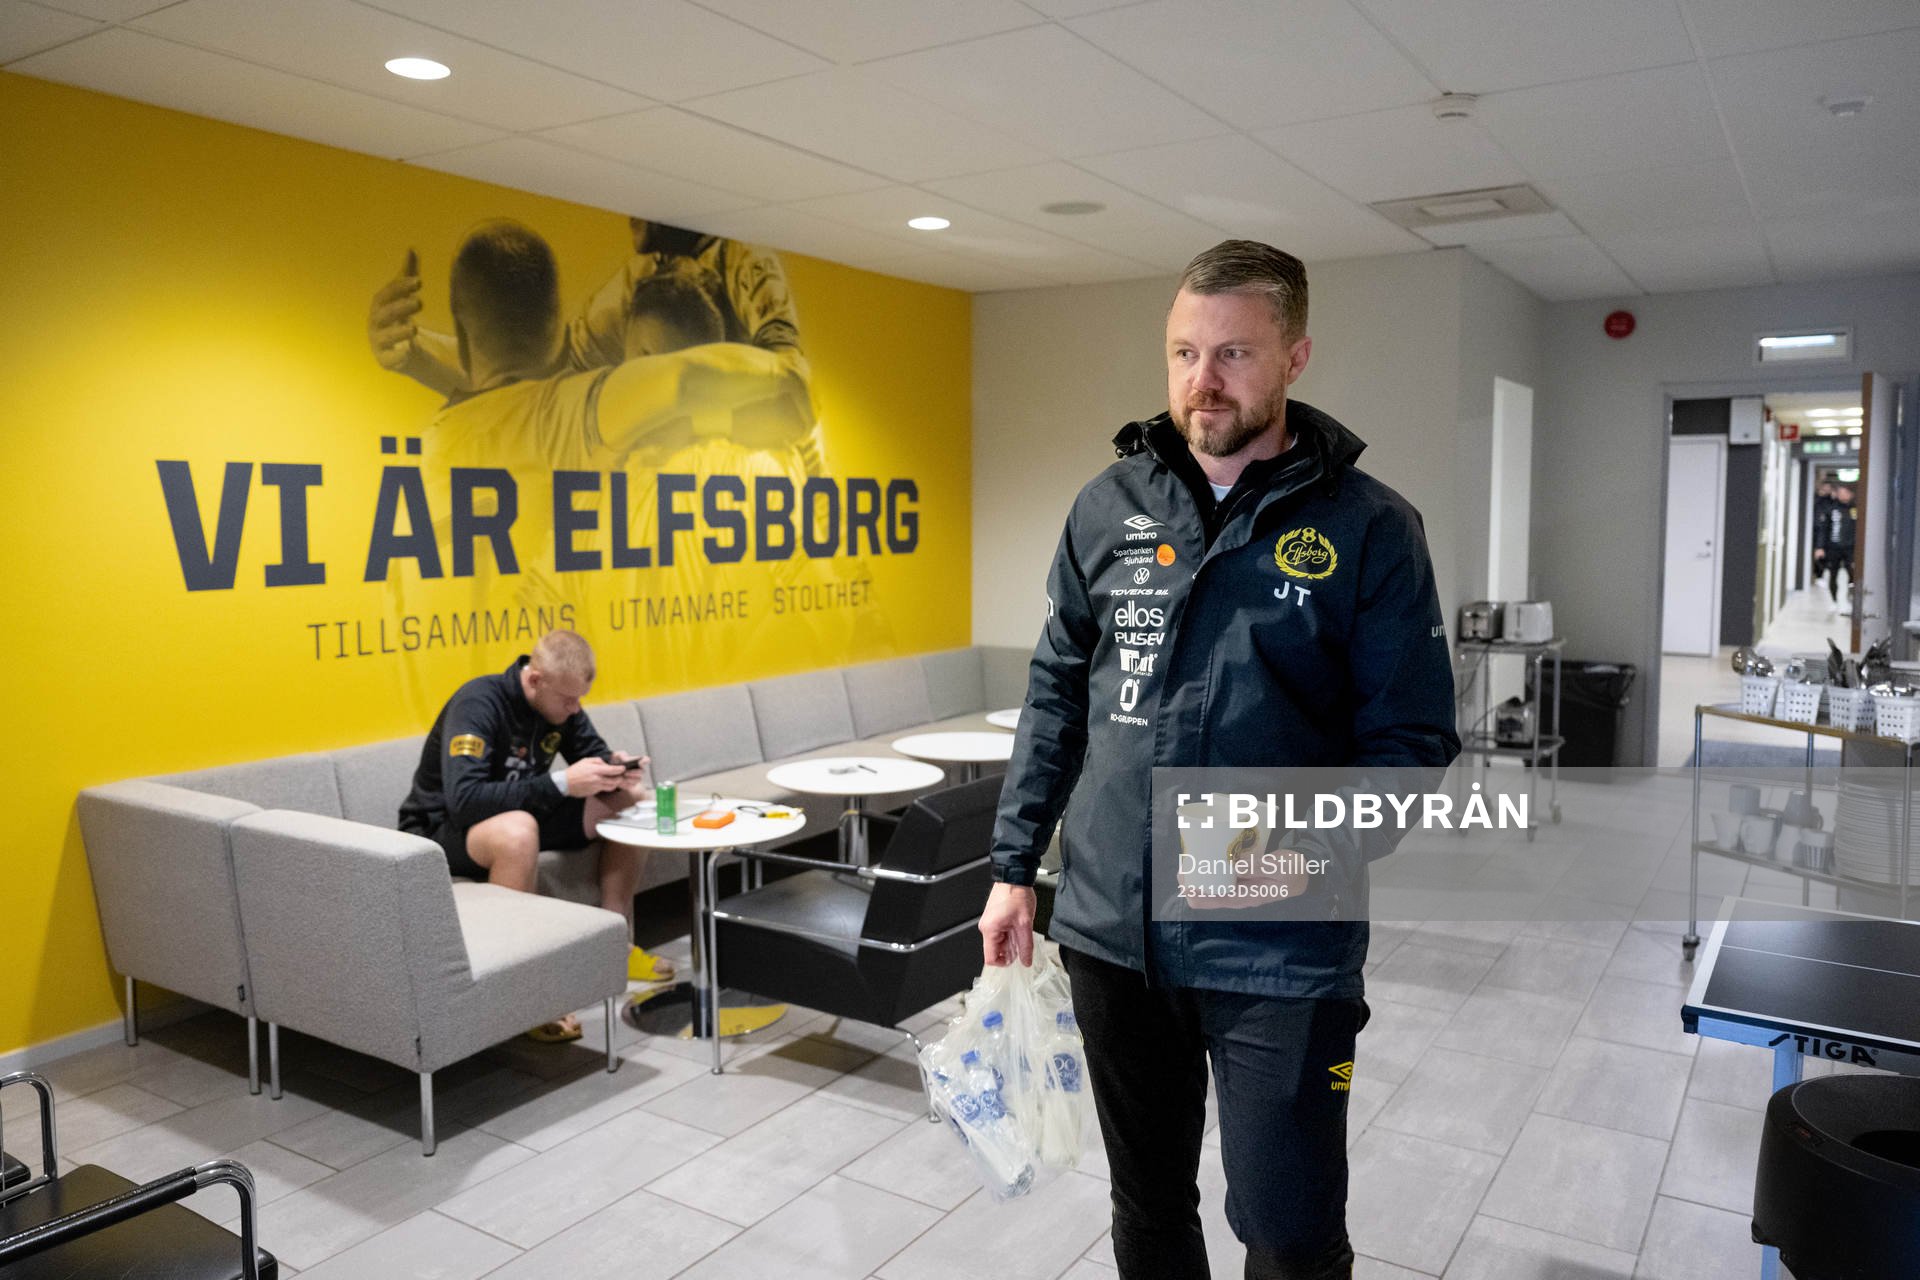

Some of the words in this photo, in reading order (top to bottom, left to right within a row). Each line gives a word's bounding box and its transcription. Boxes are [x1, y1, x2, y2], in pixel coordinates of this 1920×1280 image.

[155, 459, 325, 592] VI
[363, 436, 520, 582] ÄR
[553, 470, 919, 572] ELFSBORG
[1125, 531, 1157, 541] umbro
[1113, 546, 1154, 558] Sparbanken
[1110, 588, 1153, 596] TOVEKS
[306, 604, 576, 660] TILLSAMMANS
[610, 590, 748, 631] UTMANARE
[773, 580, 871, 614] STOLTHET
[1114, 600, 1164, 627] ellos
[1768, 1033, 1876, 1067] STIGA
